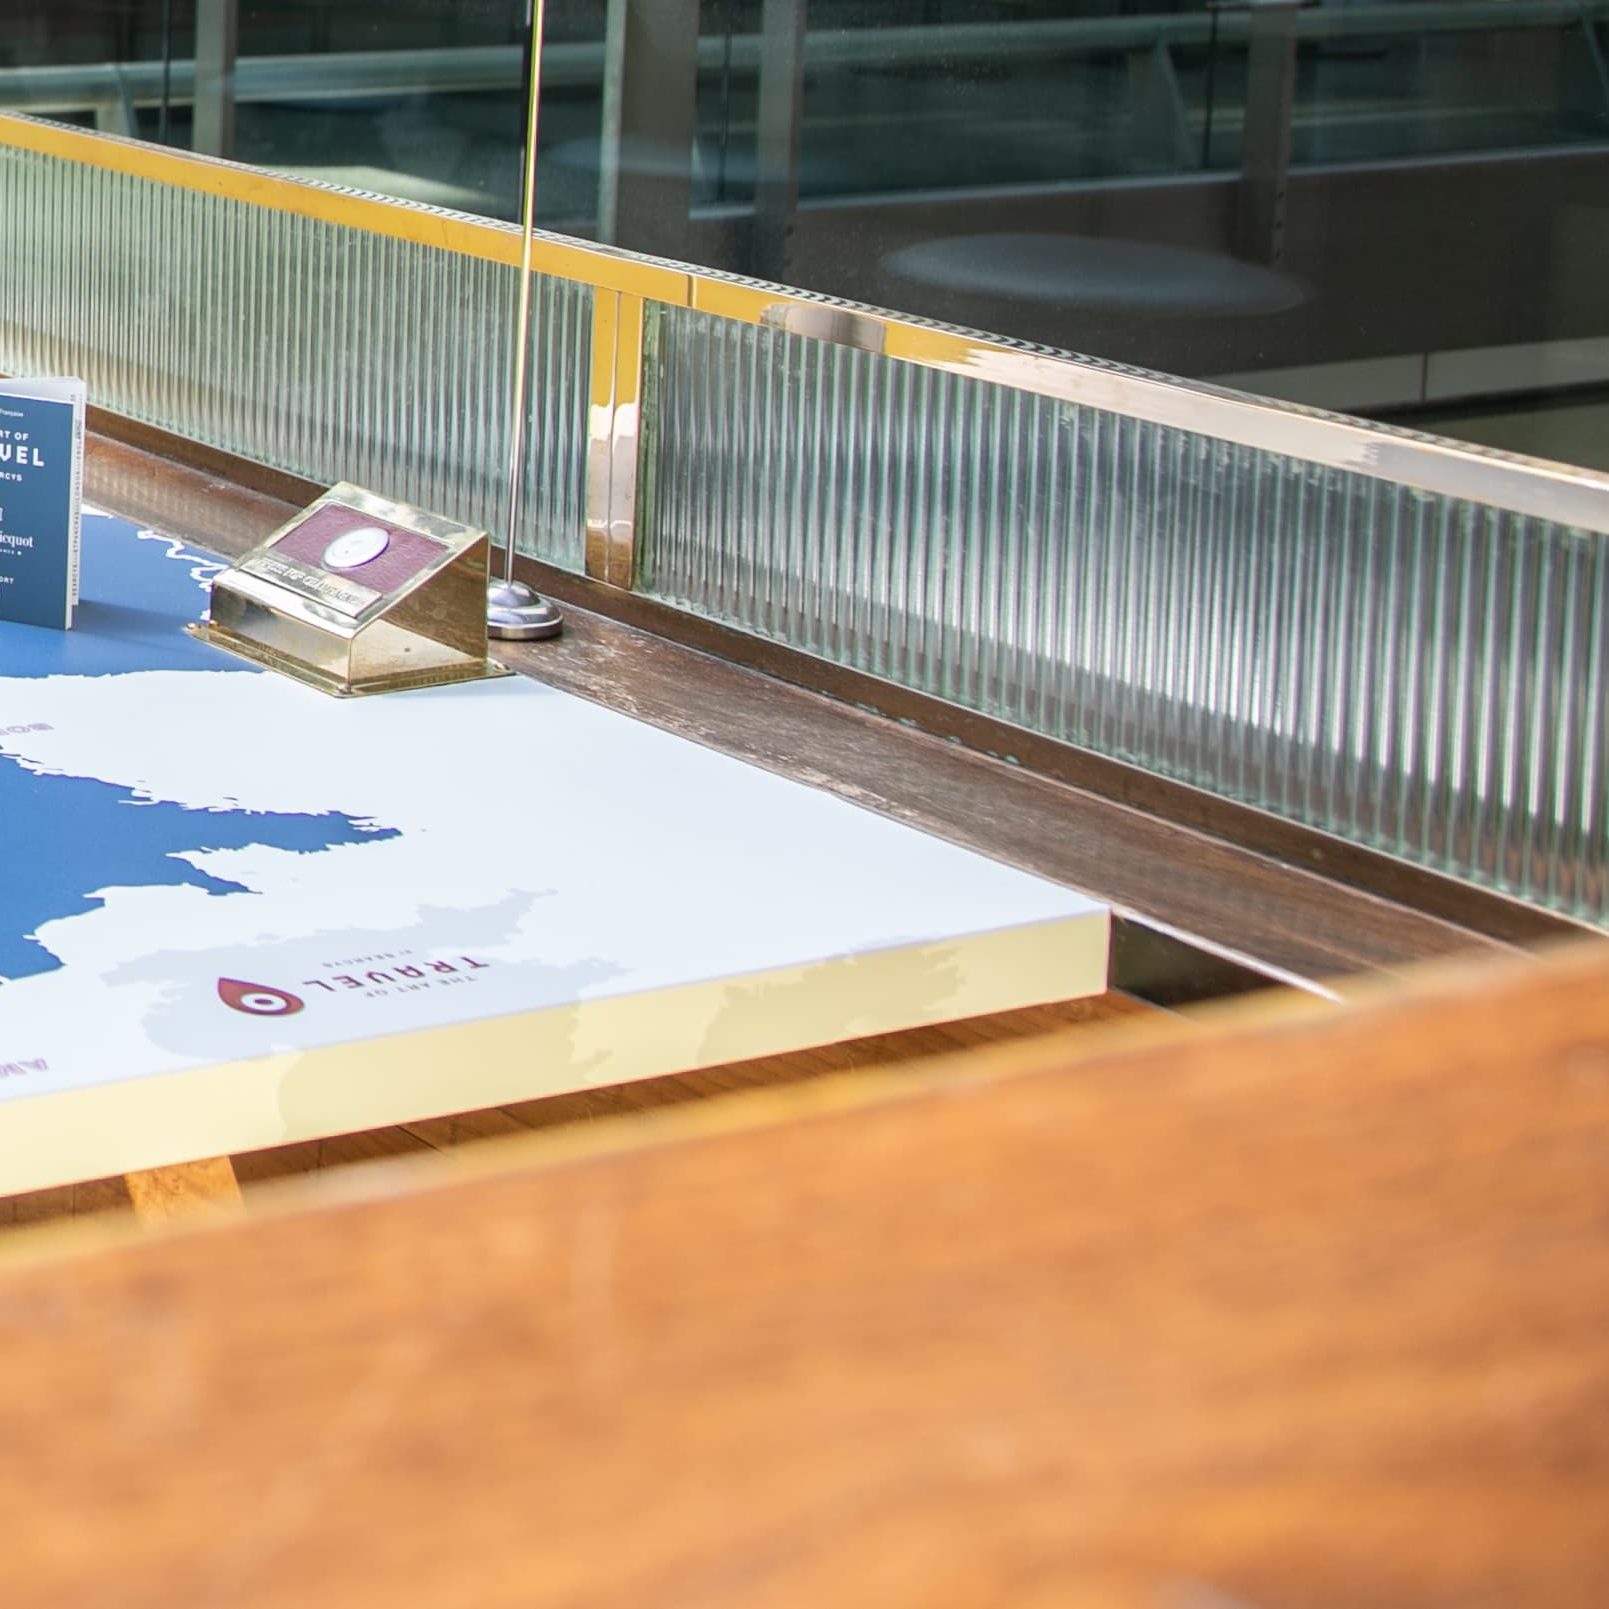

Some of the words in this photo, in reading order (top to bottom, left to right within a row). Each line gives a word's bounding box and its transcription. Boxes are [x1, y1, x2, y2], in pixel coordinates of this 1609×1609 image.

[14, 432, 29, 441] OF
[302, 955, 490, 993] TRAVEL
[438, 975, 478, 986] THE
[396, 981, 432, 993] ART
[365, 988, 388, 998] OF
